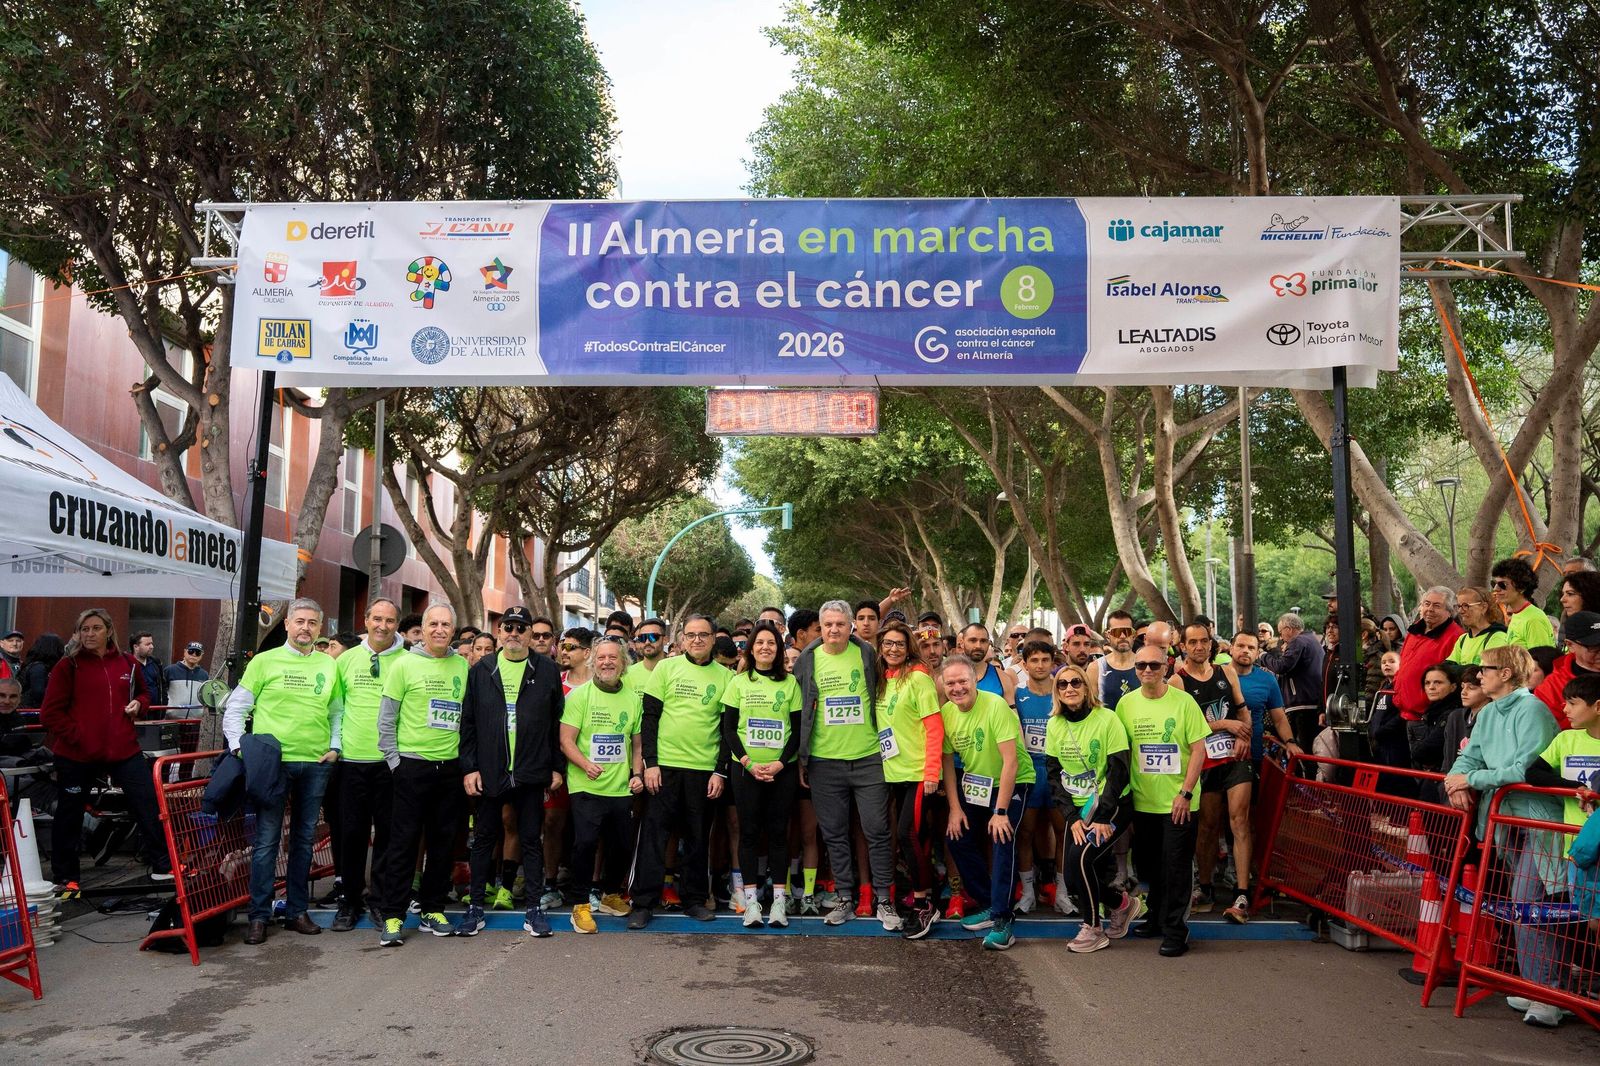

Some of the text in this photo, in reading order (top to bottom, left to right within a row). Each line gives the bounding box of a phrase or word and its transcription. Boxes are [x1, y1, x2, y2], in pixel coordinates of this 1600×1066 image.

[310, 220, 375, 240] deretil
[568, 216, 1054, 256] II Almería en marcha
[1140, 220, 1224, 242] cajamar
[1332, 226, 1392, 239] Fundación
[1312, 269, 1376, 278] FUNDACIÓN
[252, 287, 294, 297] ALMERÍA
[586, 270, 983, 309] contra el cáncer
[1017, 274, 1036, 302] 8
[1106, 282, 1221, 296] Isabel Alonso
[1312, 277, 1378, 295] primaflor
[955, 326, 1056, 339] asociación española
[1306, 320, 1350, 332] Toyota
[451, 336, 526, 346] UNIVERSIDAD
[1118, 327, 1216, 344] LEALTADIS
[1307, 333, 1383, 347] Alborán Motor
[264, 338, 306, 348] DE CABRAS
[584, 340, 726, 353] #TodosContraElCáncer
[778, 332, 845, 357] 2026
[956, 338, 1035, 348] contra el cáncer
[451, 346, 526, 356] DE ALMERÍA
[972, 350, 1013, 360] Almería
[828, 706, 861, 718] 1275
[750, 729, 782, 741] 1800
[598, 745, 621, 756] 826
[1146, 754, 1171, 766] 571
[963, 784, 988, 798] 1253
